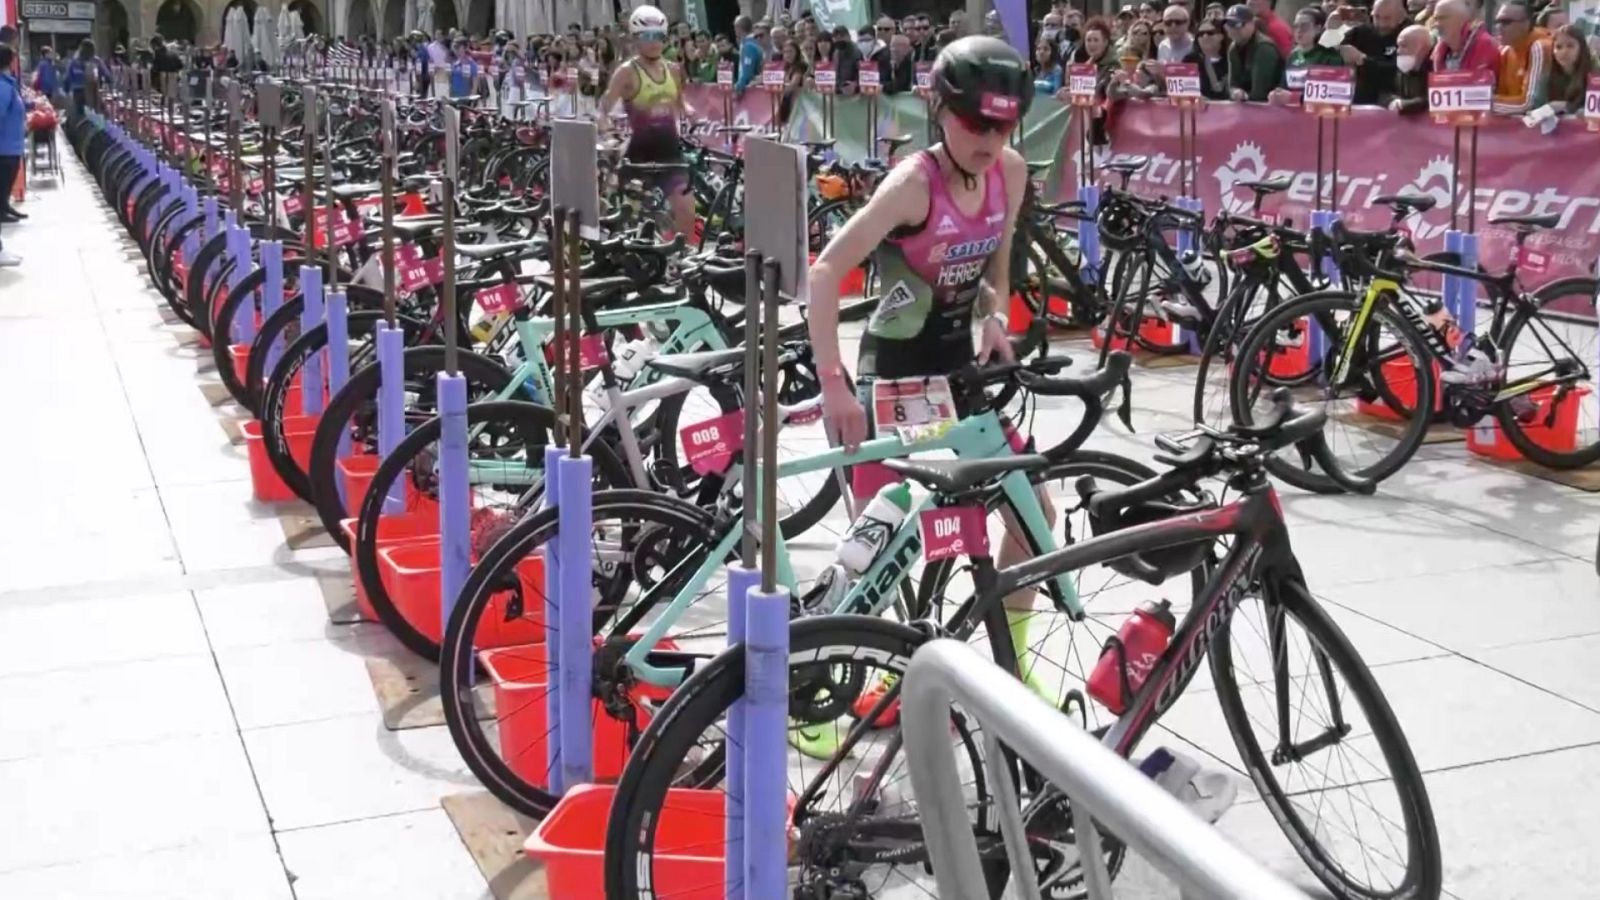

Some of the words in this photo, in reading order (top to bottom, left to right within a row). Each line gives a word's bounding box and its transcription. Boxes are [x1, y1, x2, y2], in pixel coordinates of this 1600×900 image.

[25, 4, 67, 16] SEIKO
[1168, 76, 1184, 93] 015
[1306, 83, 1328, 99] 013
[1431, 90, 1462, 107] 011
[482, 293, 502, 306] 014
[692, 426, 720, 446] 008
[934, 516, 960, 538] 004
[844, 525, 921, 614] Bian
